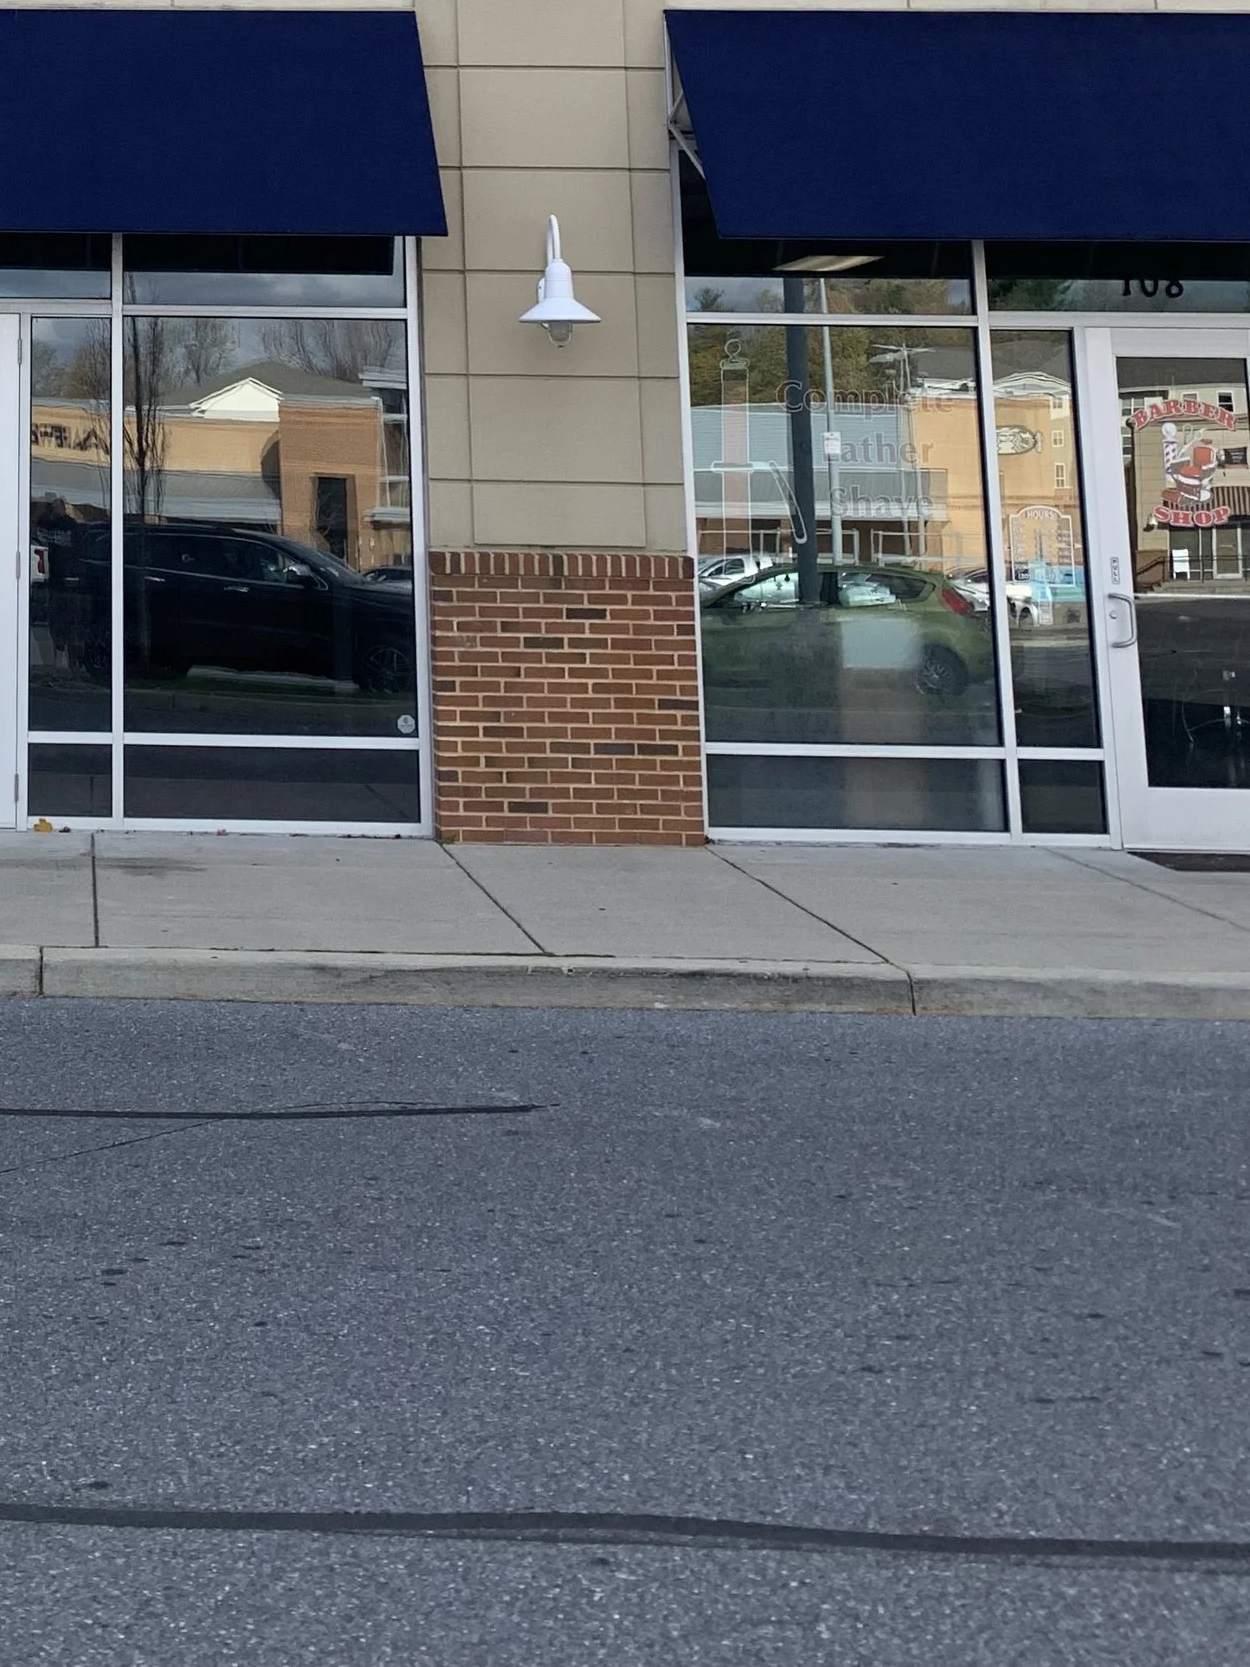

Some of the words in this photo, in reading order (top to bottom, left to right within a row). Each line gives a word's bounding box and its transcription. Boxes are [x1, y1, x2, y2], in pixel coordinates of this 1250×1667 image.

[776, 380, 954, 421] Complete
[1133, 399, 1237, 432] BARBER
[821, 432, 936, 464] Lather
[830, 484, 935, 518] Shave
[1026, 509, 1055, 519] HOURS
[1153, 505, 1230, 527] SHOP
